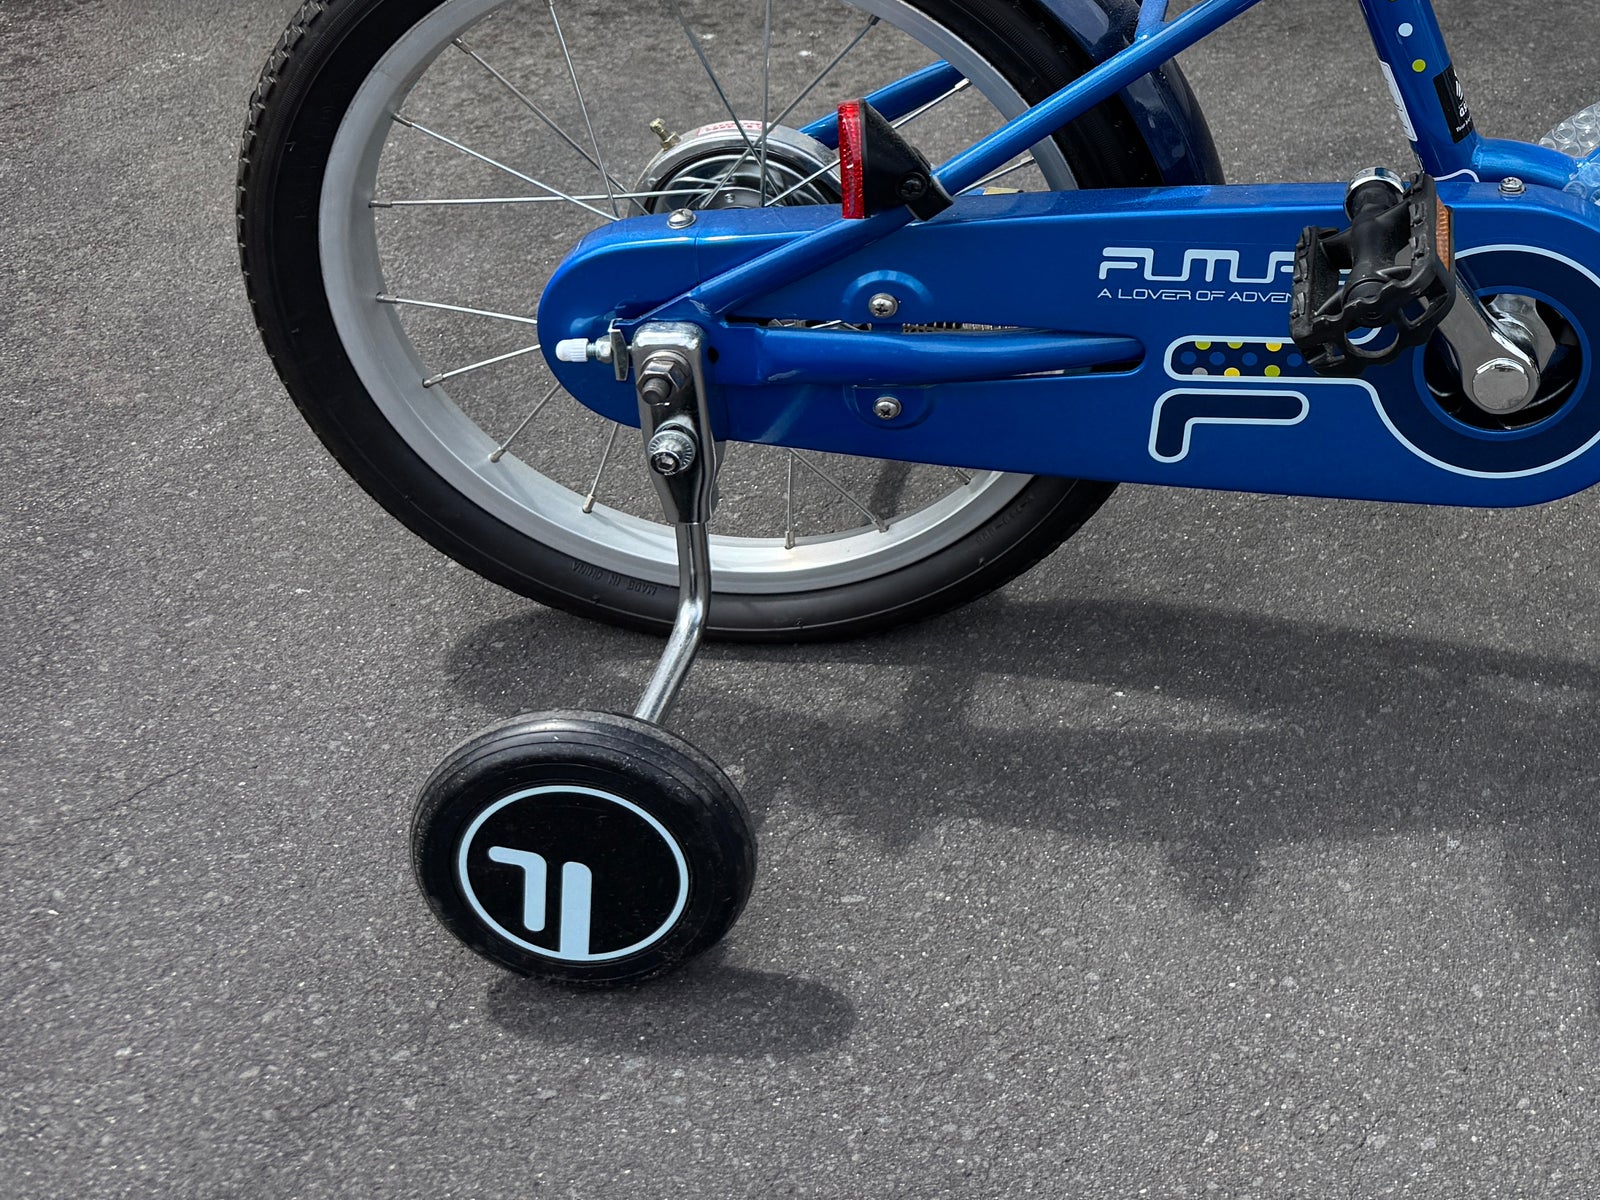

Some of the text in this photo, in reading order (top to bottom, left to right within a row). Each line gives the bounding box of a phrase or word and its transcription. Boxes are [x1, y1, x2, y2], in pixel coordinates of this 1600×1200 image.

[1097, 288, 1112, 299] A
[1118, 288, 1191, 301] LOVER
[1196, 290, 1226, 301] OF
